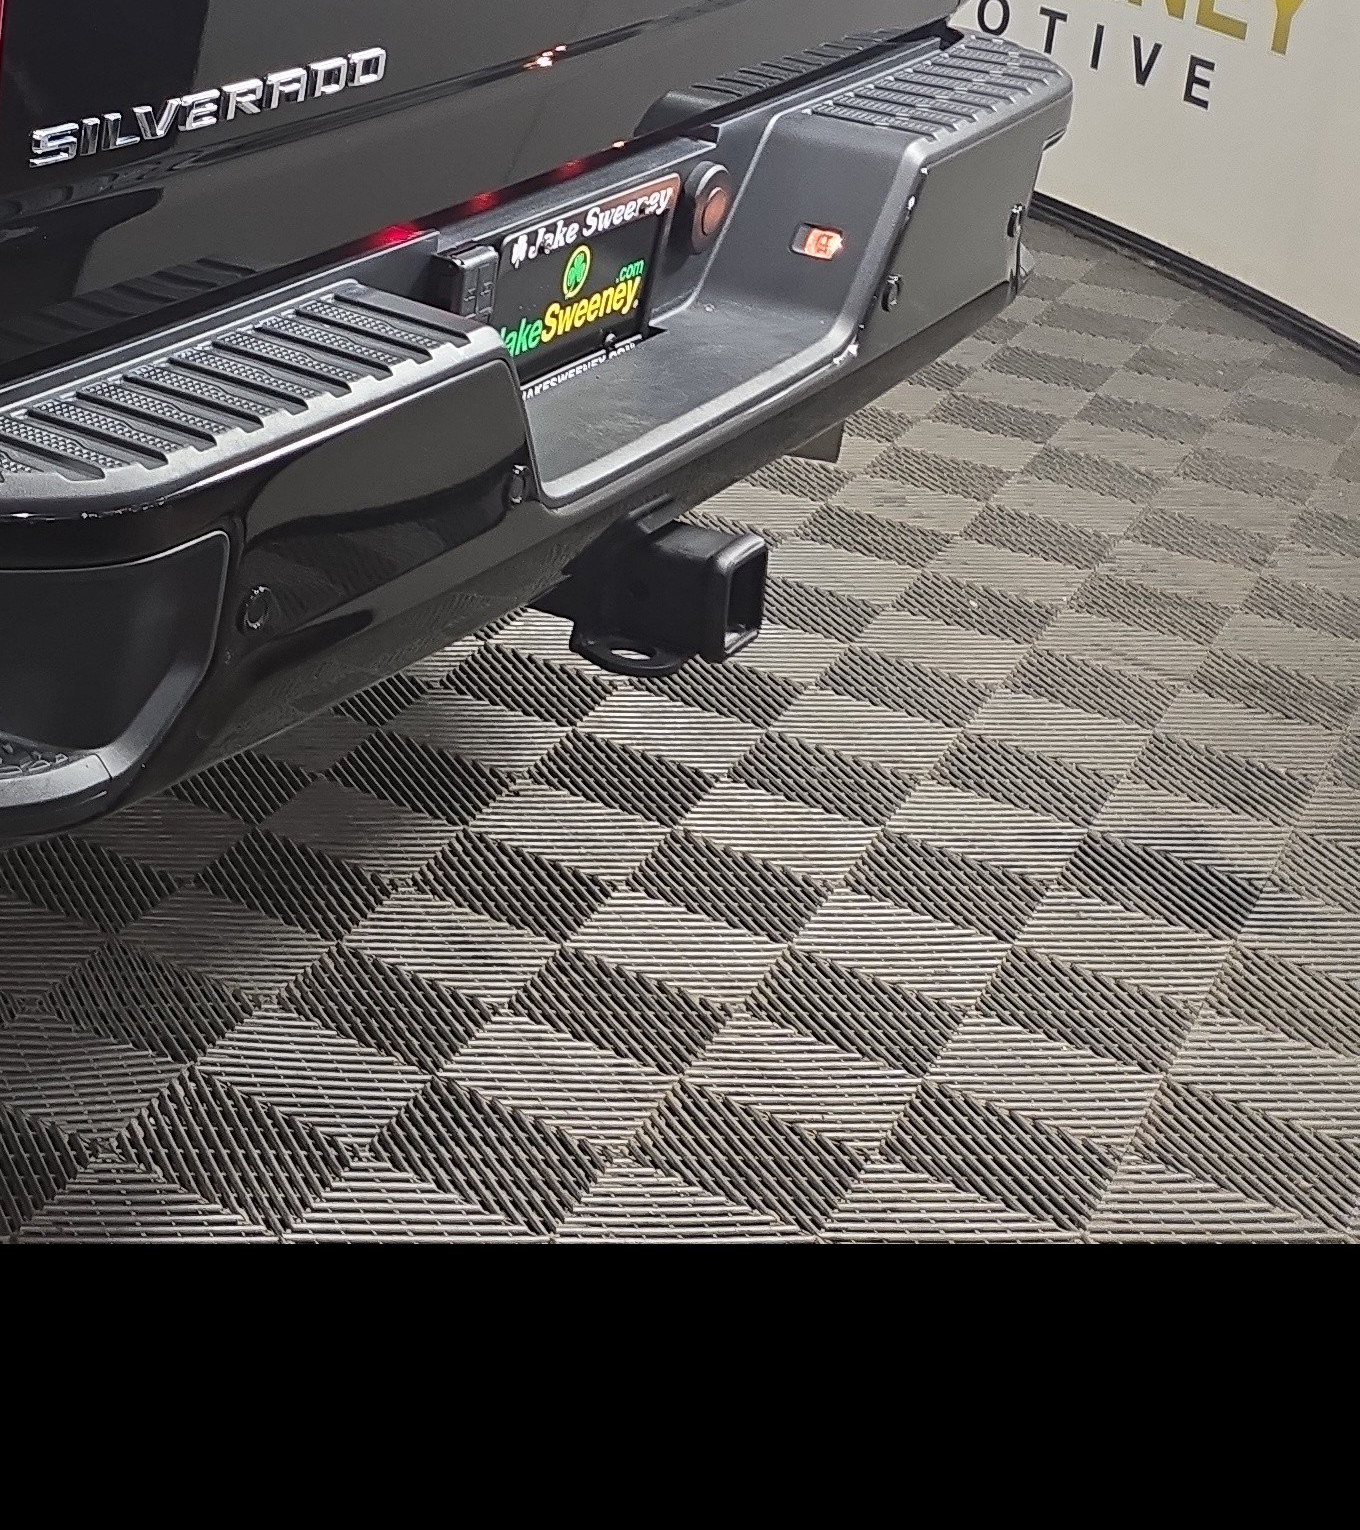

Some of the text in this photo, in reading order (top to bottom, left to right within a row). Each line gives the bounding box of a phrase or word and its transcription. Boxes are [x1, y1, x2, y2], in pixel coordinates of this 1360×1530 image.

[29, 47, 387, 168] SILVERADO
[528, 187, 674, 260] Jake Sweeney
